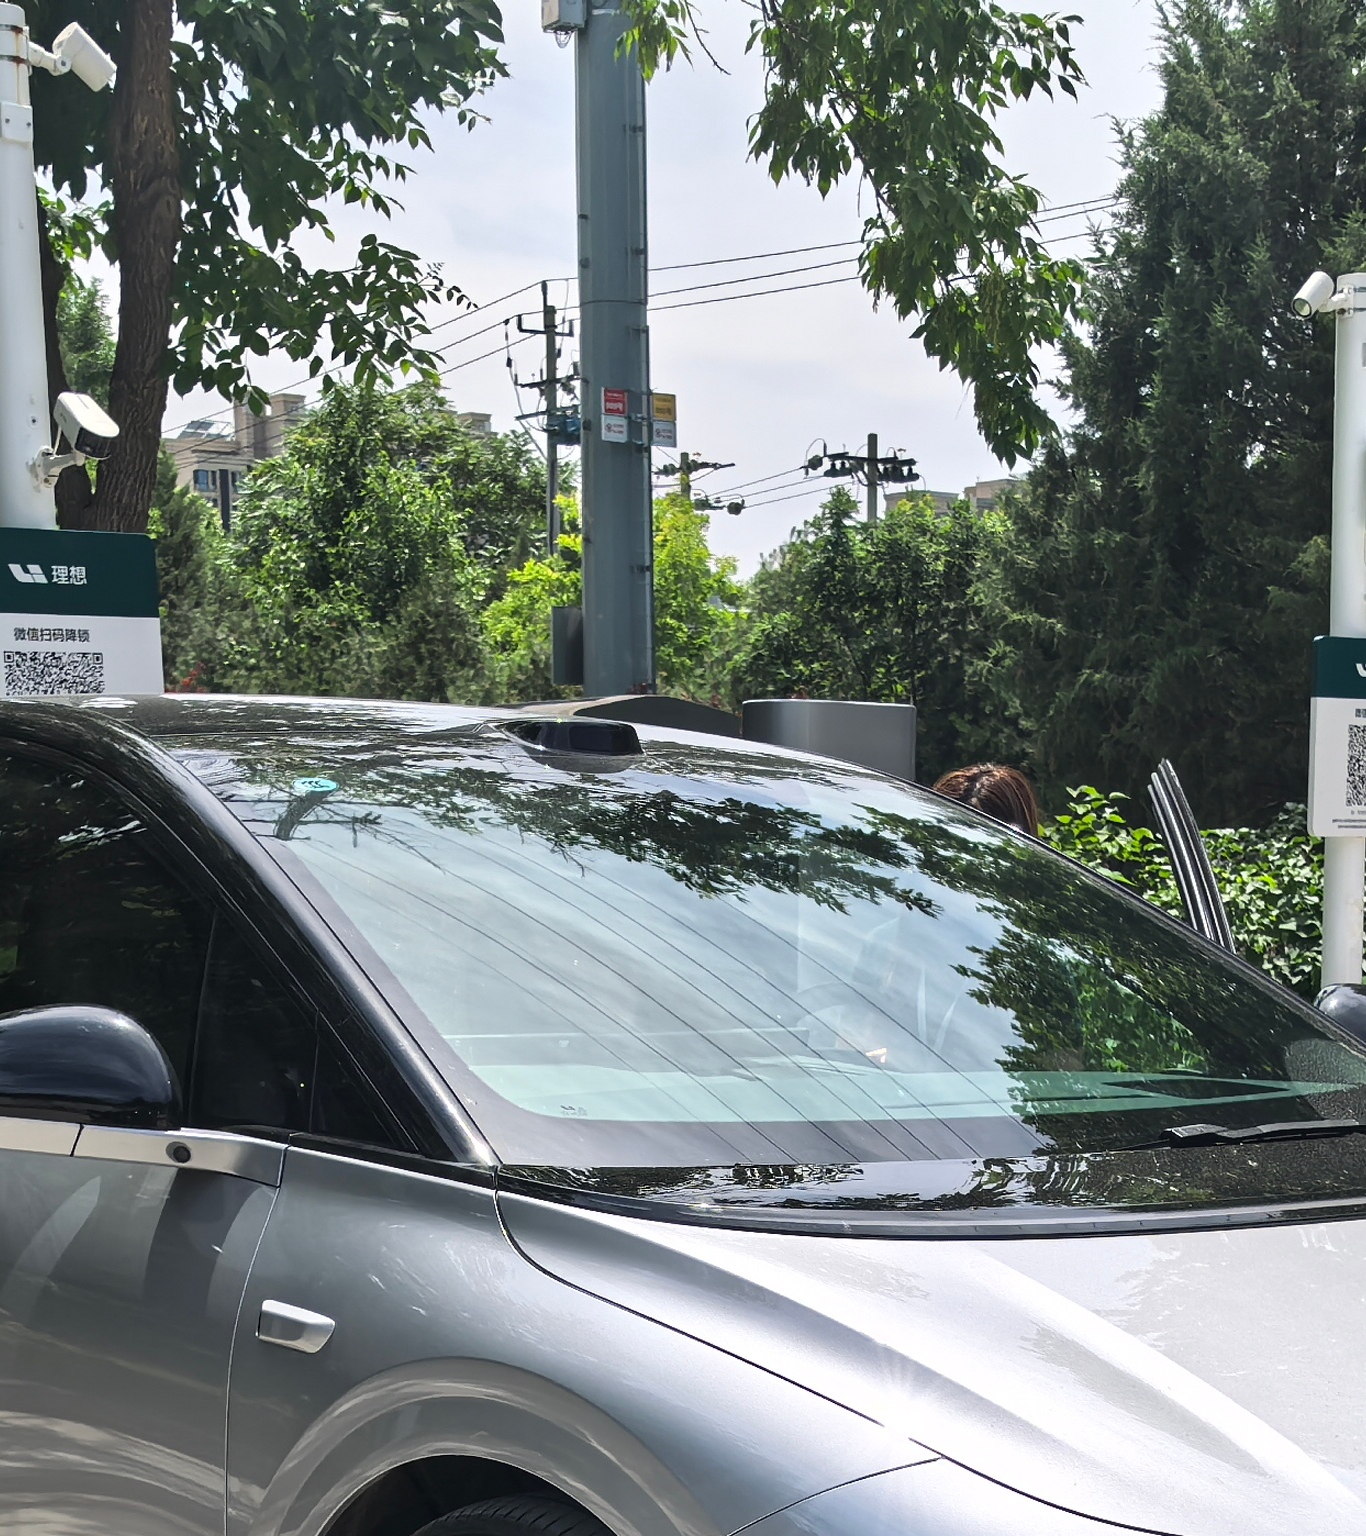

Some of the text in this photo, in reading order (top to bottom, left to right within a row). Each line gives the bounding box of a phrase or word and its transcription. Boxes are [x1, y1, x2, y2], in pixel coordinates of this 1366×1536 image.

[51, 565, 87, 585] 理想
[14, 627, 90, 642] 微信扫码降锁
